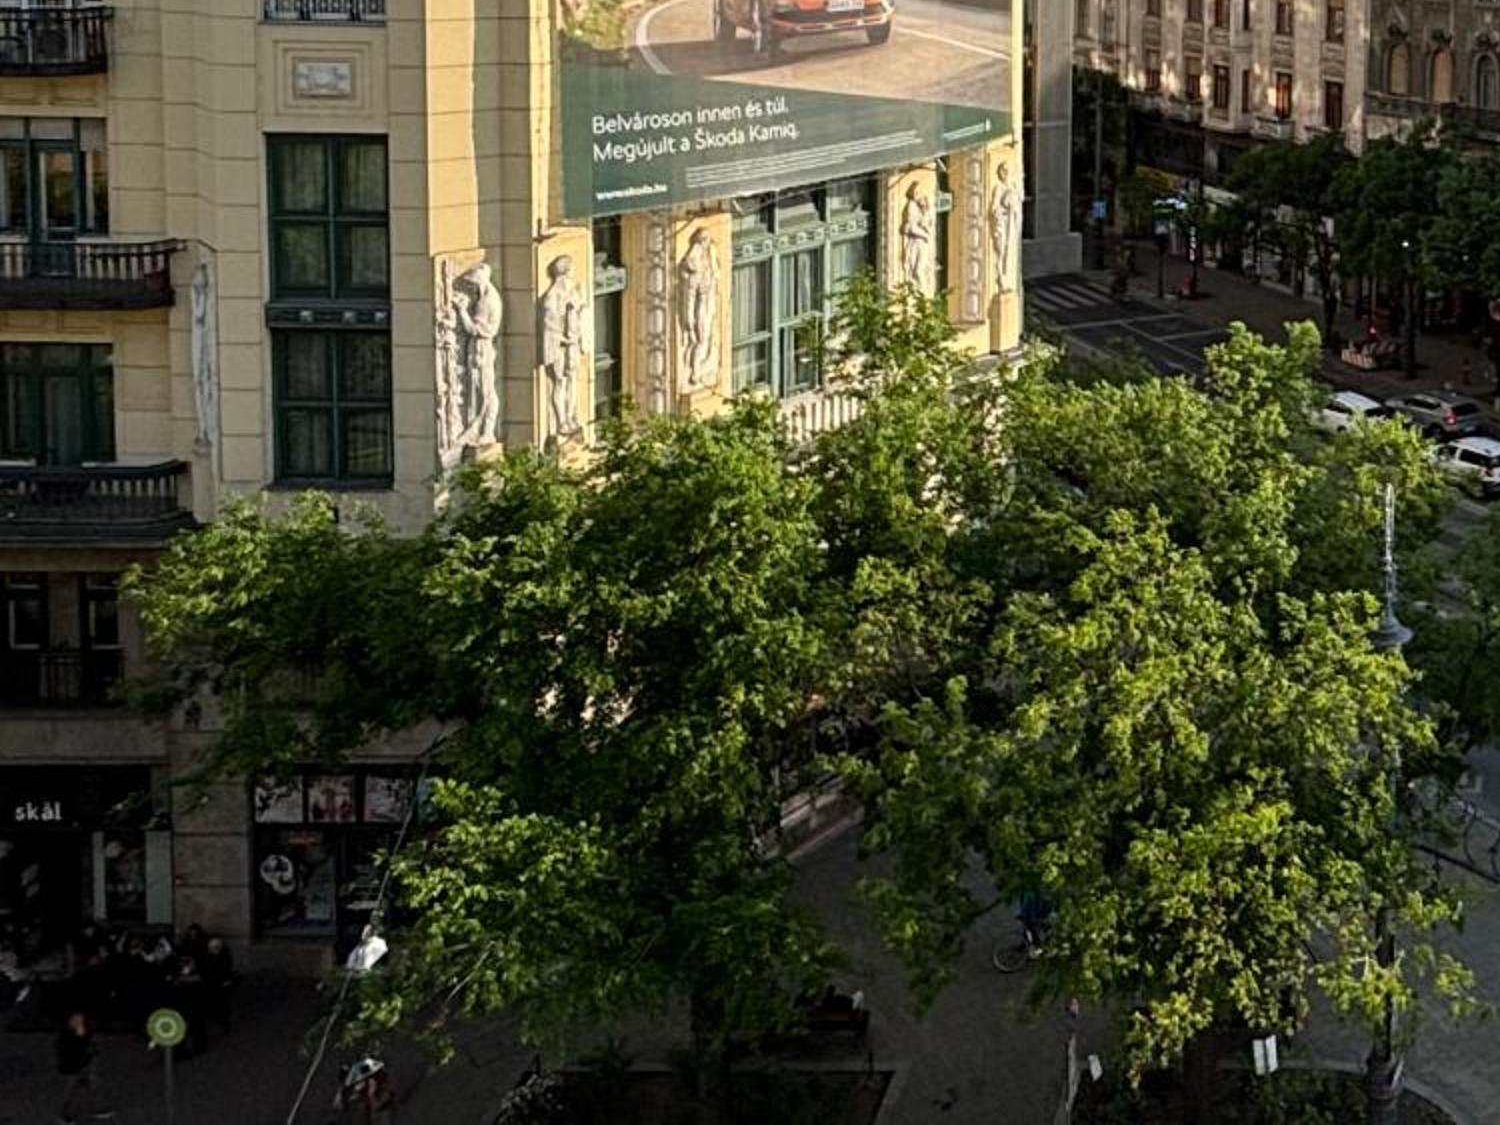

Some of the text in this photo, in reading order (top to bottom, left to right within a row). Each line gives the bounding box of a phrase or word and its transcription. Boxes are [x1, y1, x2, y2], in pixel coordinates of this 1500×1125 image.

[592, 96, 789, 135] Belvároson innen és túl.
[593, 135, 676, 163] Megújult
[680, 139, 691, 152] a
[694, 128, 745, 151] Škoda
